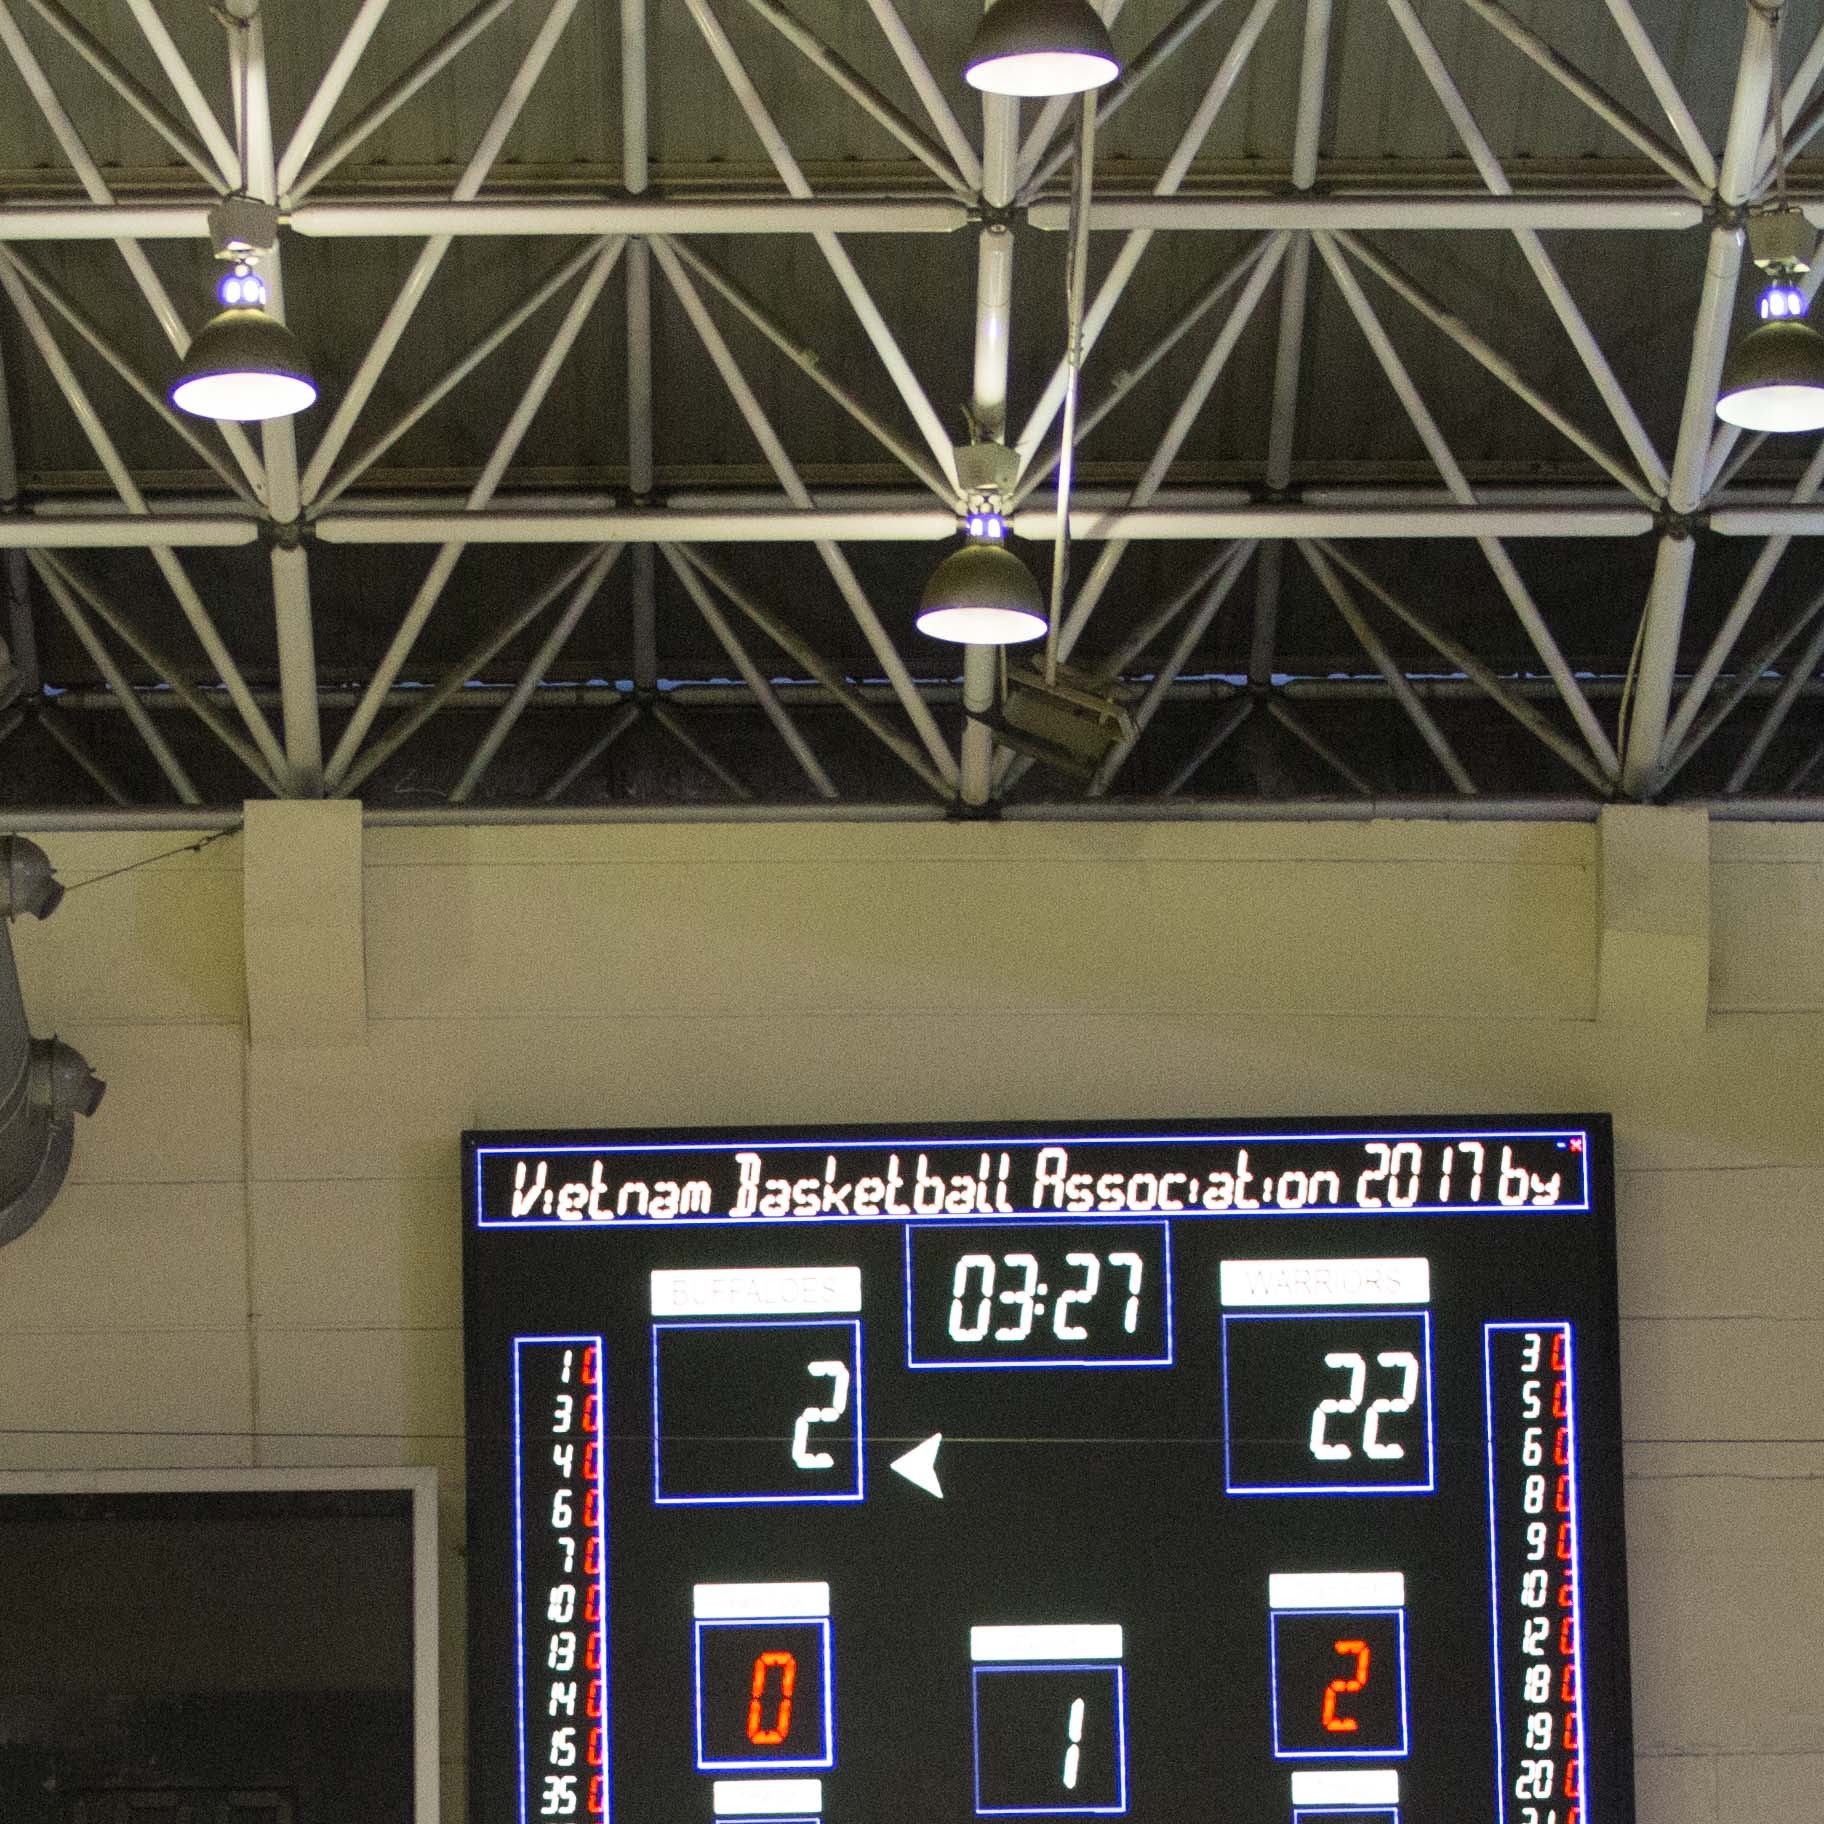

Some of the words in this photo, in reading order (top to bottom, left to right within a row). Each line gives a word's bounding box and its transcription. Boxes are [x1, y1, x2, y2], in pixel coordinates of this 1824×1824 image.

[511, 1160, 713, 1219] Vietnam
[729, 1152, 1013, 1217] Basketball
[1032, 1146, 1341, 1210] Association
[1357, 1141, 1485, 1207] 2017
[1498, 1145, 1561, 1206] by
[948, 1252, 1144, 1342] 03:27
[561, 1349, 573, 1384] 1
[1520, 1333, 1541, 1372] 3
[552, 1394, 574, 1433] 3
[791, 1360, 850, 1469] 2
[1309, 1351, 1420, 1461] 22
[1522, 1380, 1541, 1419] 5
[552, 1443, 574, 1479] 4
[1522, 1427, 1543, 1467] 6
[551, 1488, 573, 1529] 6
[1523, 1474, 1546, 1514] 8
[558, 1536, 576, 1573] 7
[1526, 1521, 1547, 1561] 9
[547, 1584, 576, 1623] 10
[1520, 1569, 1549, 1608] 10
[547, 1631, 577, 1671] 13
[1522, 1616, 1550, 1656] 12
[548, 1681, 577, 1717] 14
[746, 1649, 796, 1746] 0
[1321, 1638, 1371, 1733] 2
[1523, 1663, 1551, 1704] 18
[549, 1726, 577, 1767] 15
[1062, 1697, 1085, 1790] 1
[1525, 1711, 1553, 1751] 19
[540, 1775, 578, 1815] 35
[1515, 1759, 1555, 1800] 20
